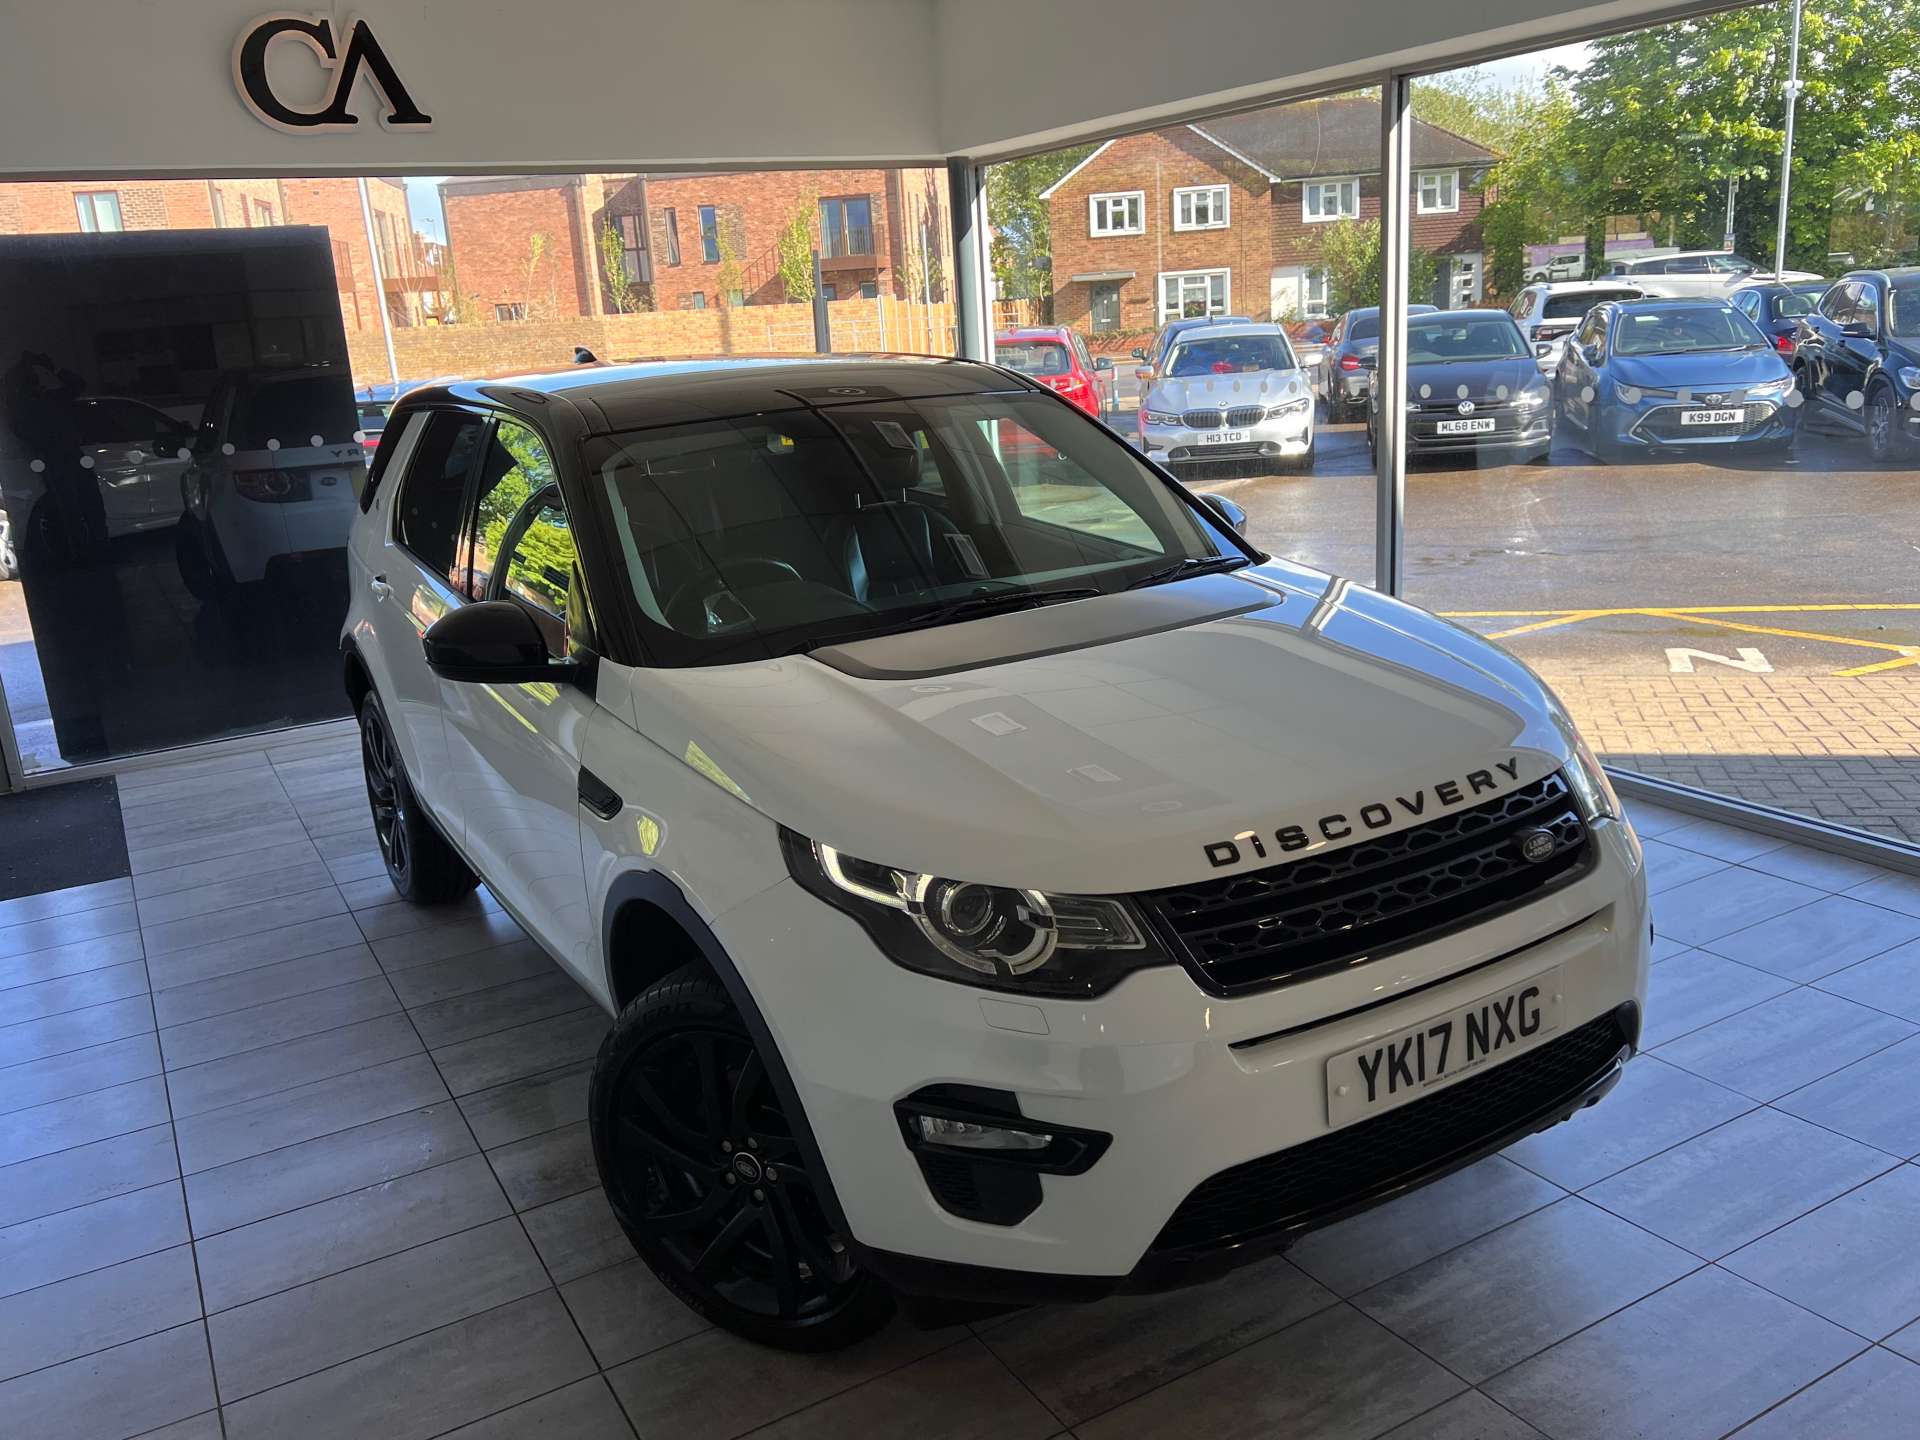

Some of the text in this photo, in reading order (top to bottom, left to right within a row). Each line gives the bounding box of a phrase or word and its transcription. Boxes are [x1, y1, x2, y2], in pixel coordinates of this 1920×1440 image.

[240, 18, 432, 127] CA
[1689, 411, 1736, 423] K99 DGN
[1203, 756, 1519, 868] DISCOVERY
[1357, 986, 1541, 1103] YK17 NXG
